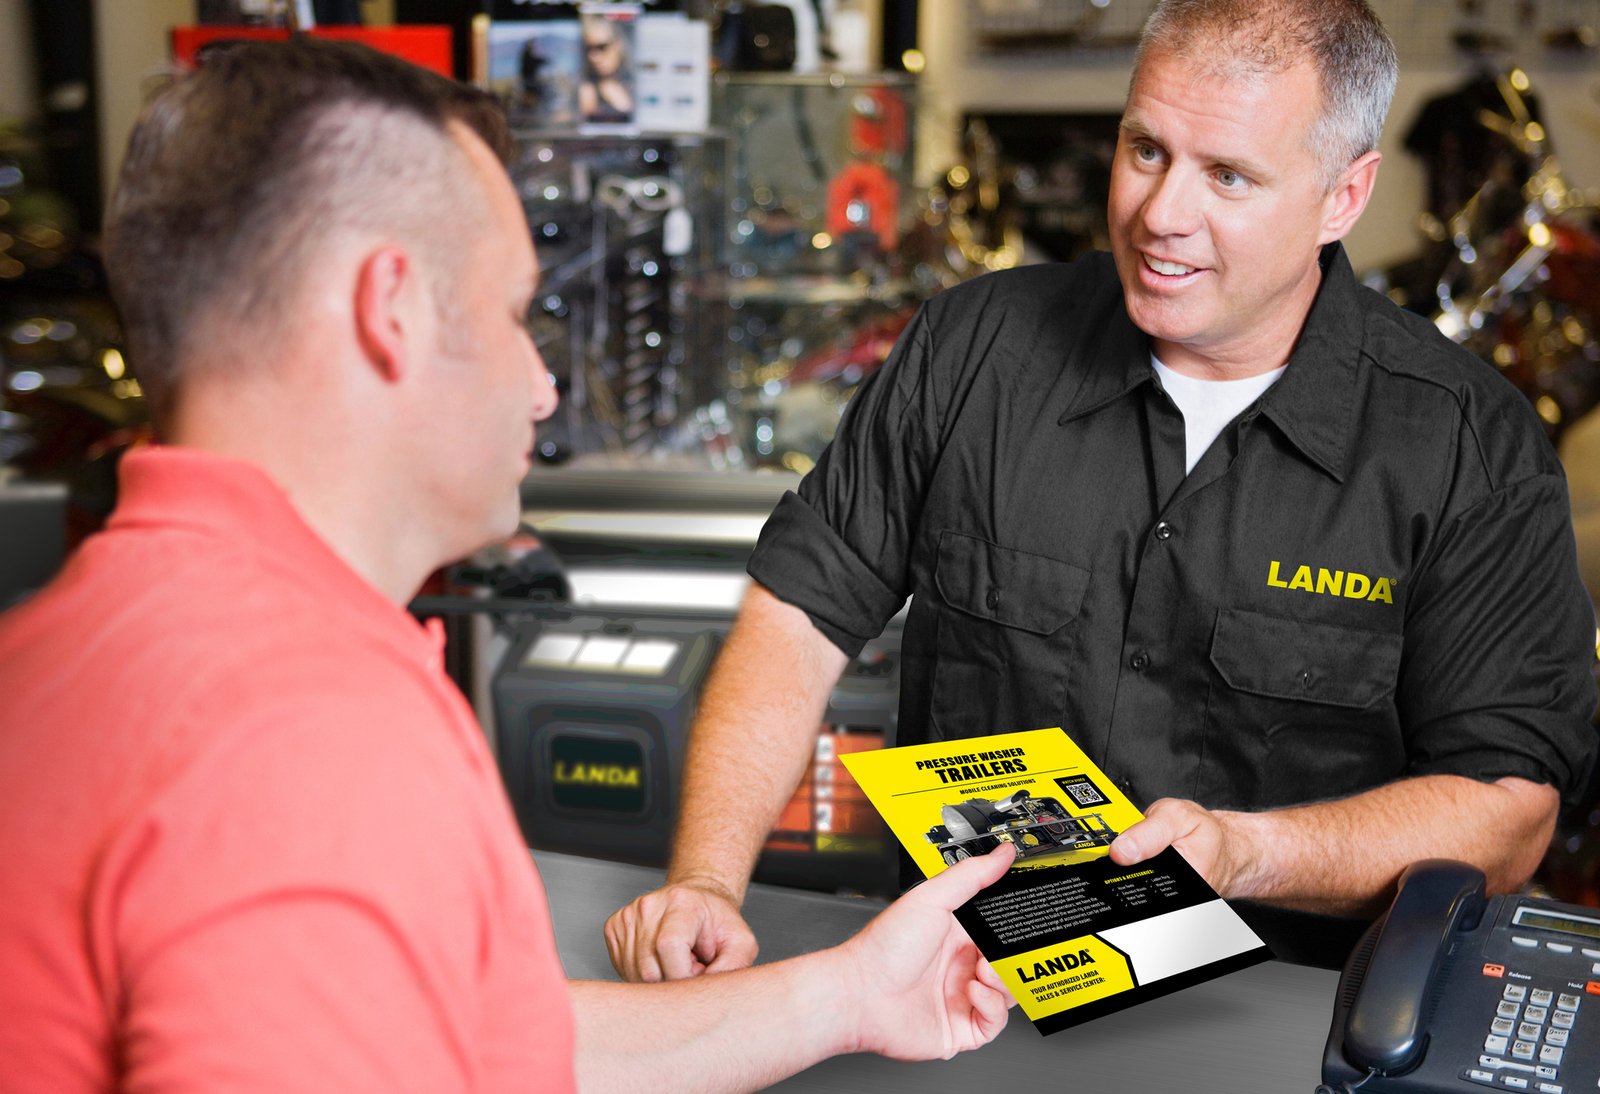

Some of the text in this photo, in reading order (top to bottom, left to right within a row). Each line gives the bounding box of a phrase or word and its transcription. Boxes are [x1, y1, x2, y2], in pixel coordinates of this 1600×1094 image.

[915, 748, 1025, 770] PRESSURE WASHER
[934, 758, 1027, 784] TRAILERS
[556, 761, 638, 786] LANDA
[981, 783, 1008, 791] CLEANING
[1007, 778, 1036, 787] SOLUTIONS
[1030, 970, 1099, 995] YOUR AUTHORIZED LANDA
[1508, 972, 1532, 980] Release
[1036, 992, 1055, 1002] SALES
[1059, 984, 1083, 995] SERVICE
[1082, 977, 1106, 988] CENTER:
